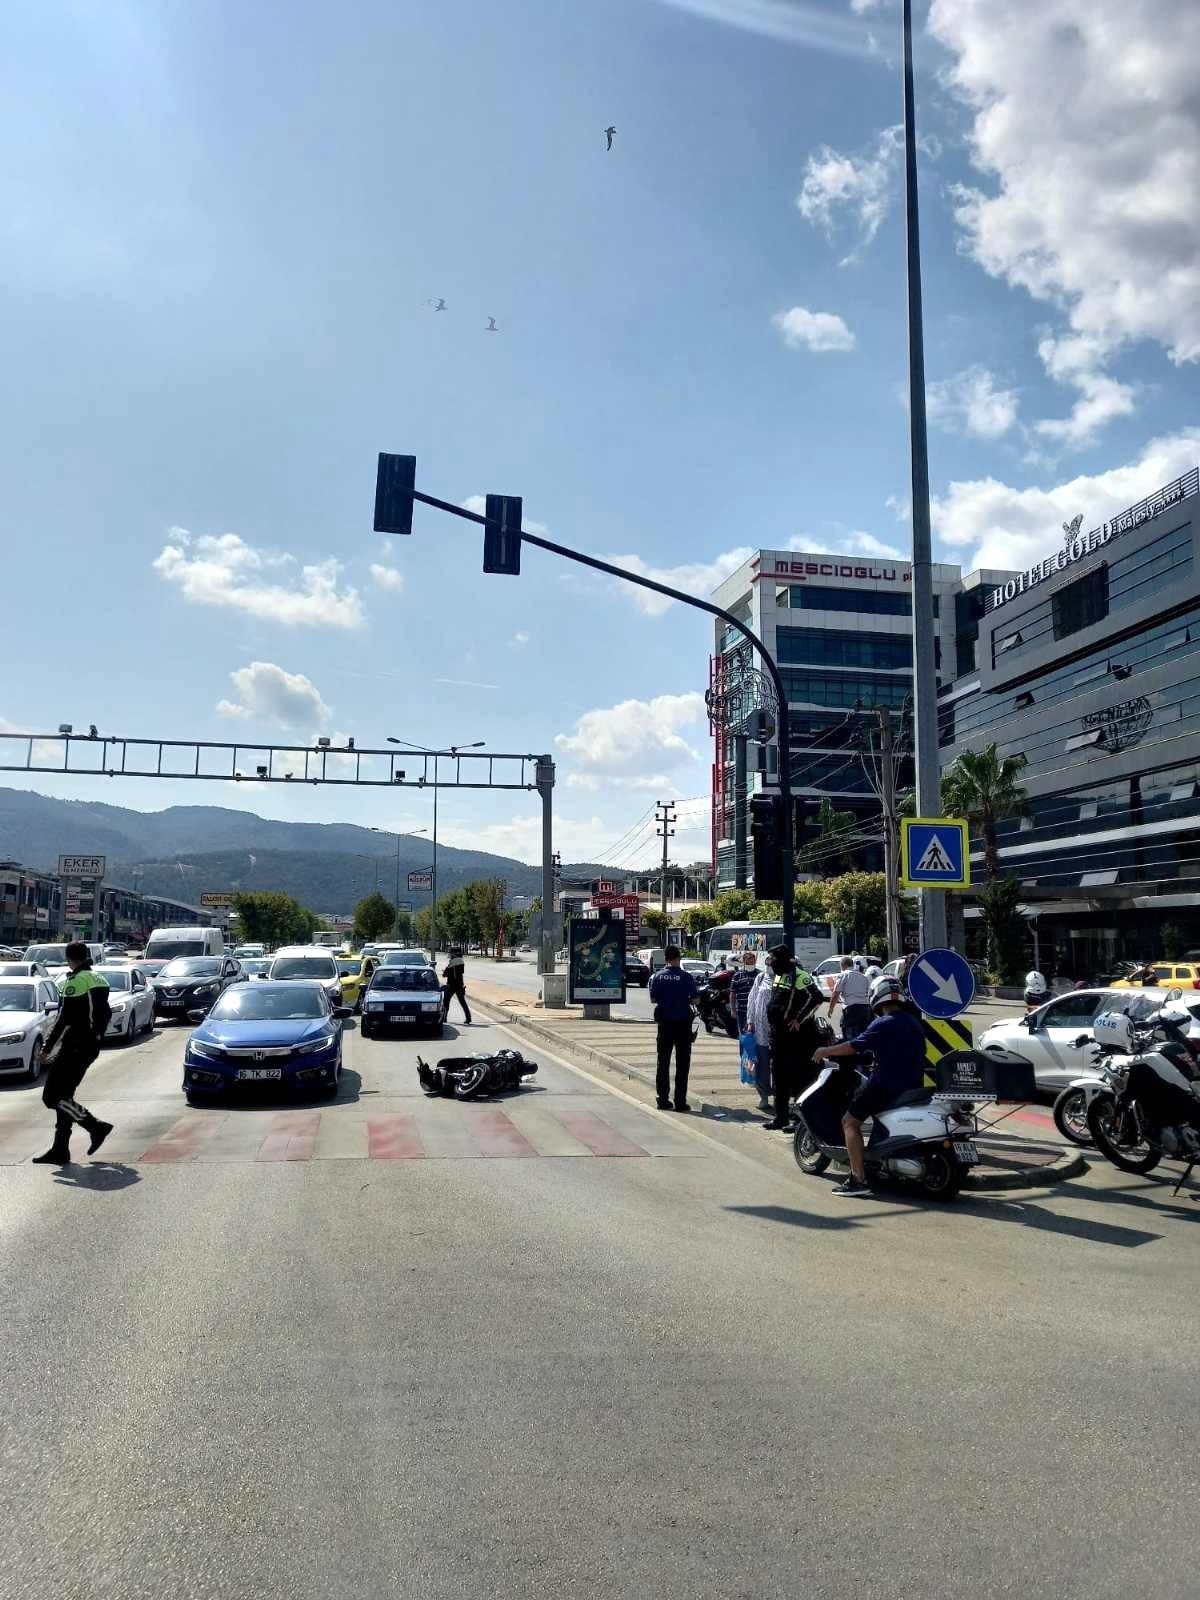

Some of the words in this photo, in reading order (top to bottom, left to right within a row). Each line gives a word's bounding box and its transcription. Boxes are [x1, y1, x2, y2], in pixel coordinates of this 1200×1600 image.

[991, 559, 1051, 609] HOTEL
[1055, 520, 1113, 570] GOLD
[64, 858, 100, 867] EKER
